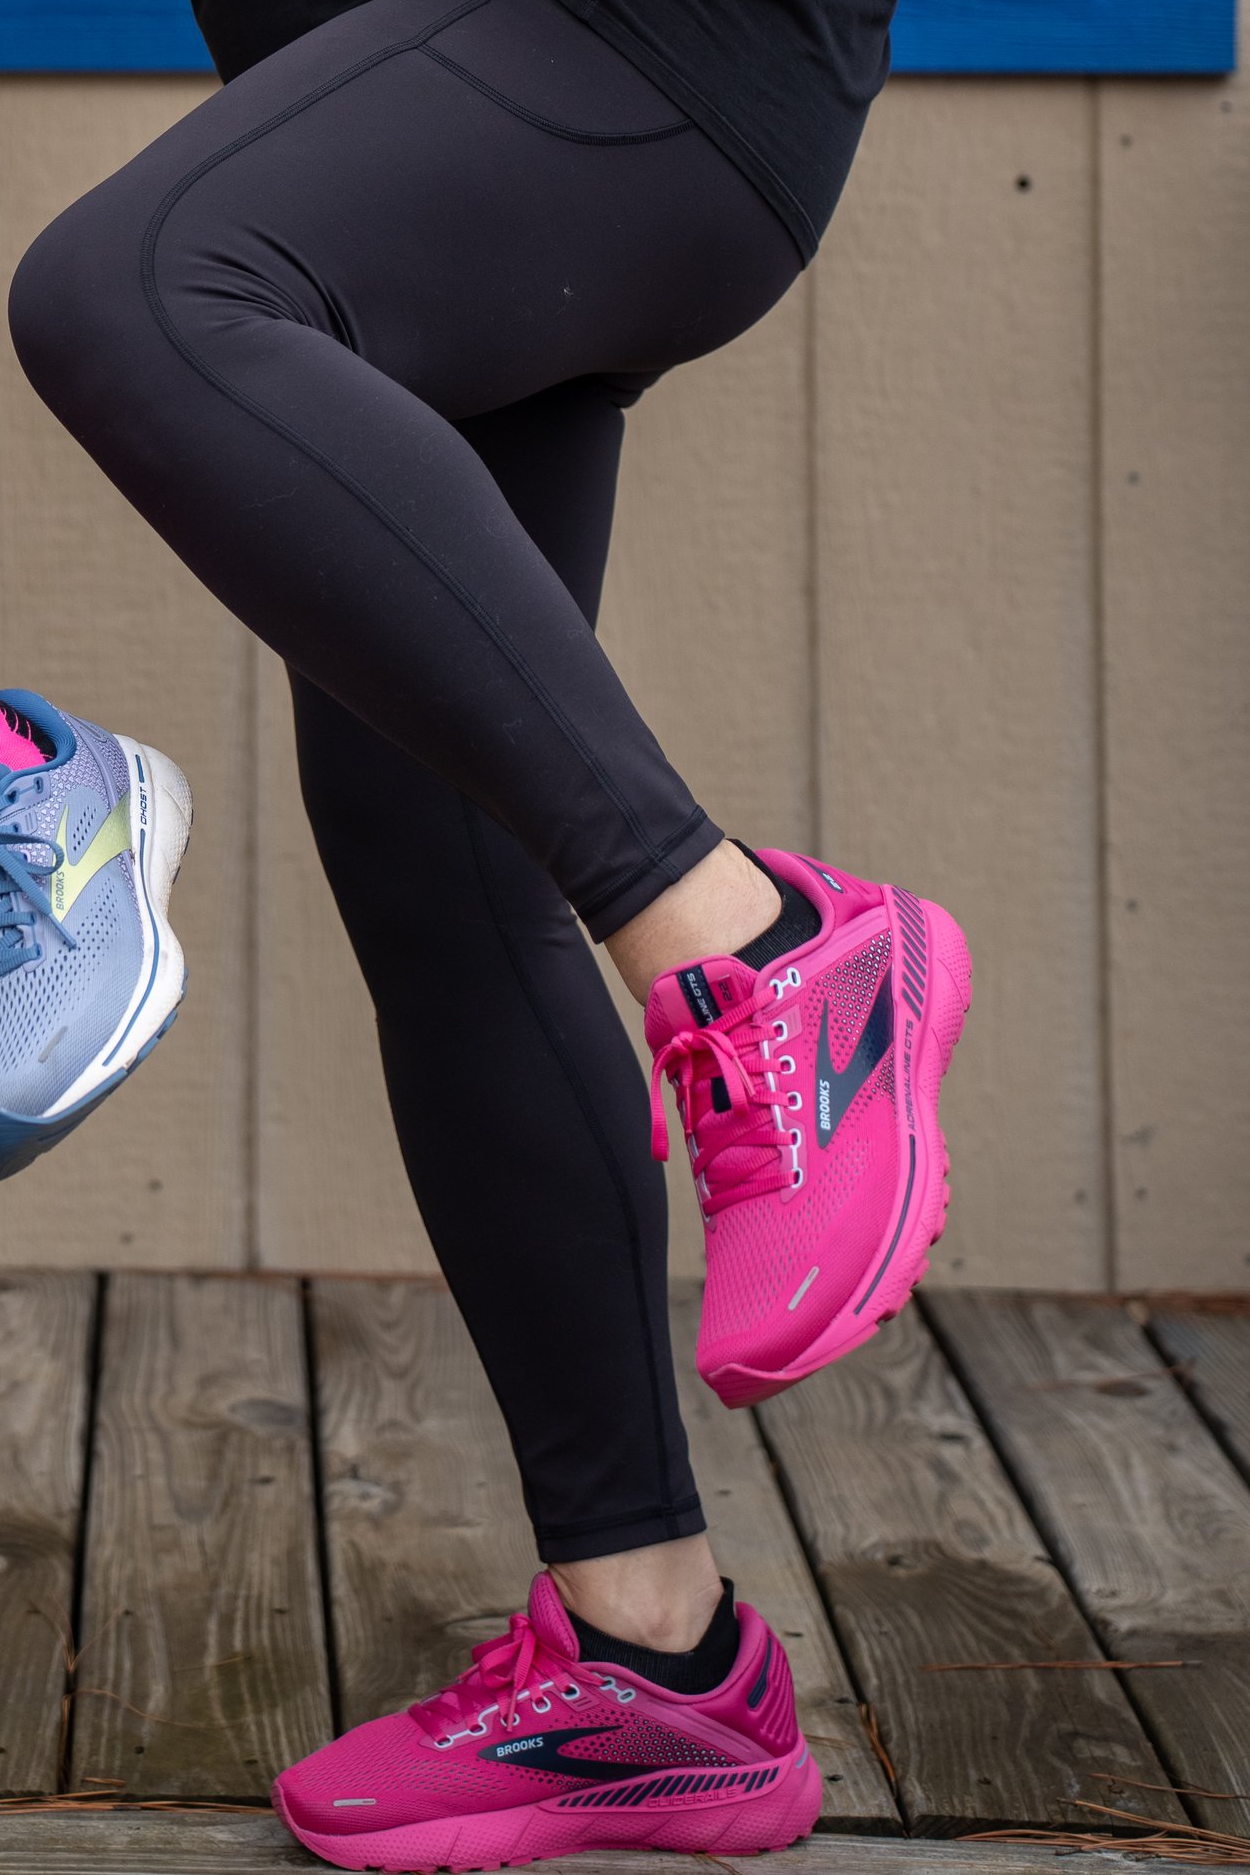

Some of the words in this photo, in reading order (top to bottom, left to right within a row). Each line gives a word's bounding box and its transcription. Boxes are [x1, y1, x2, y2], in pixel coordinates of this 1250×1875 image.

[140, 786, 149, 826] GHOST
[56, 870, 65, 910] BROOKS
[904, 1019, 913, 1049] GTS
[820, 1079, 830, 1131] BROOKS
[905, 1051, 917, 1131] ADRENALINE
[496, 1736, 544, 1758] BROOKS
